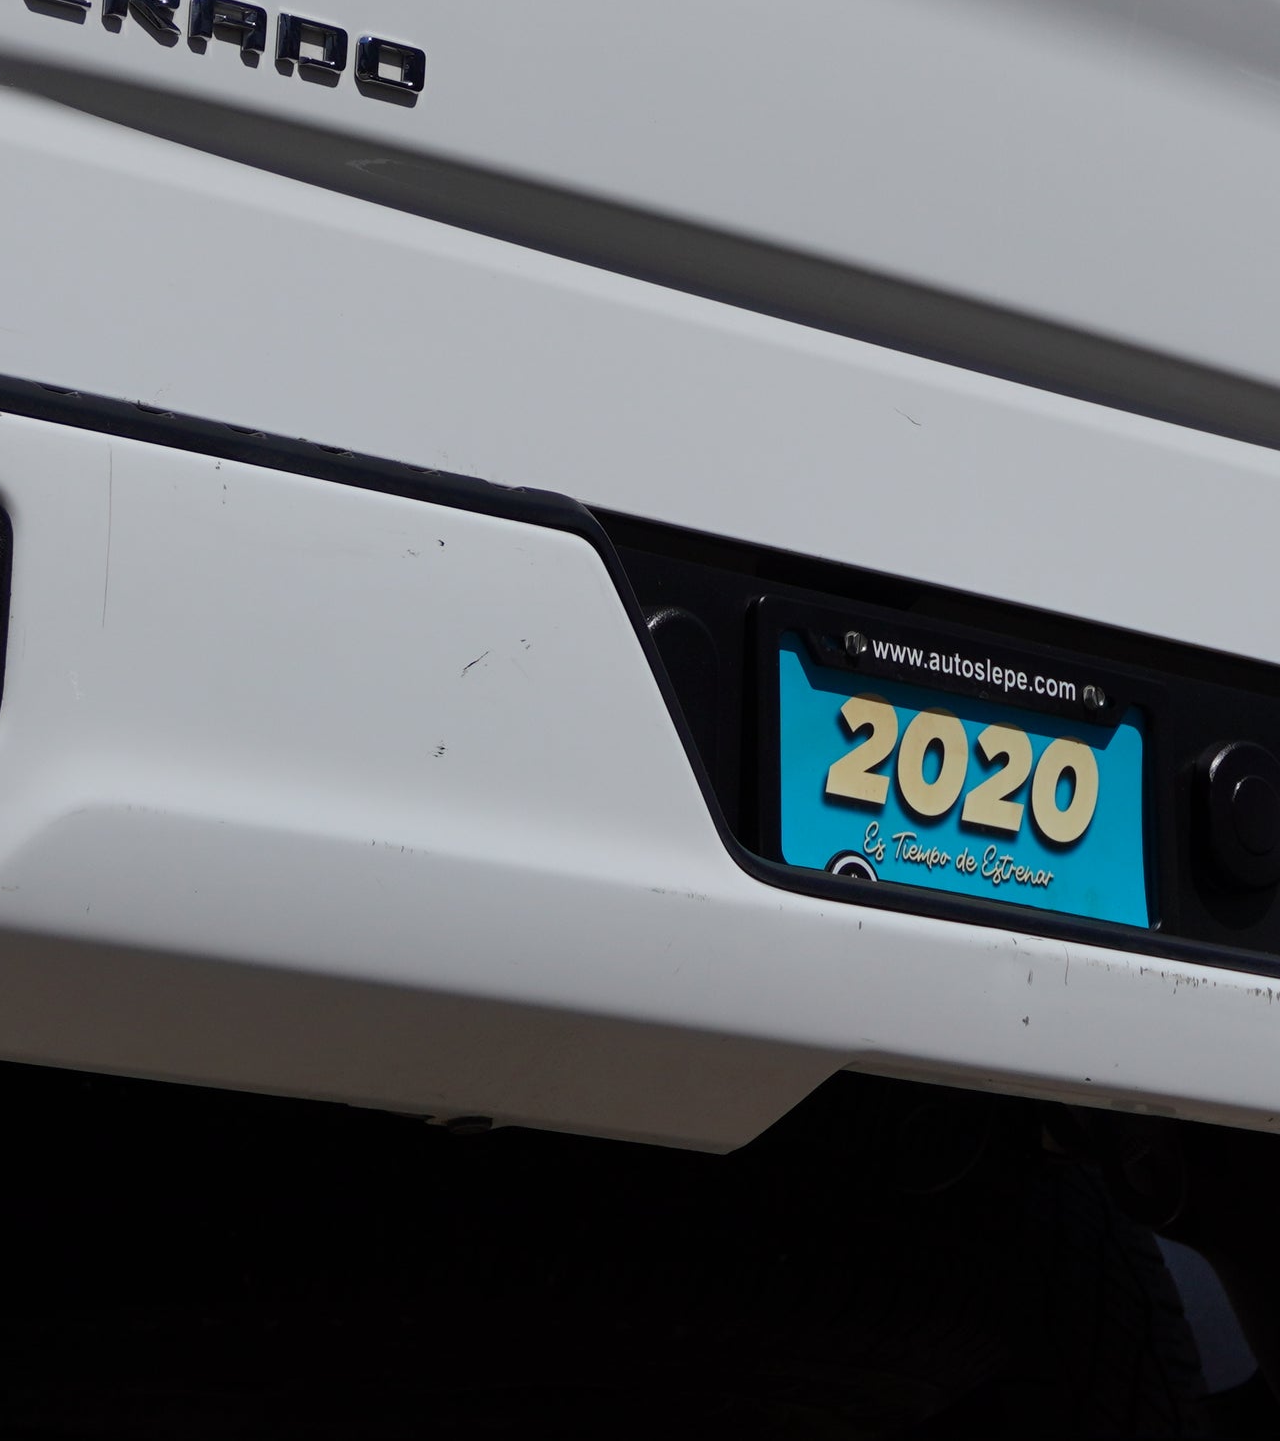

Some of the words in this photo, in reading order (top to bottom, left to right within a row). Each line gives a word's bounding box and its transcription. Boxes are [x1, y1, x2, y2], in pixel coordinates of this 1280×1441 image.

[872, 637, 1076, 702] www.autoslepe.com
[826, 694, 1100, 844] 2020
[863, 821, 887, 862] Es
[892, 831, 951, 871] Tiempo
[955, 848, 978, 873] de
[981, 844, 1055, 888] Estrenar
